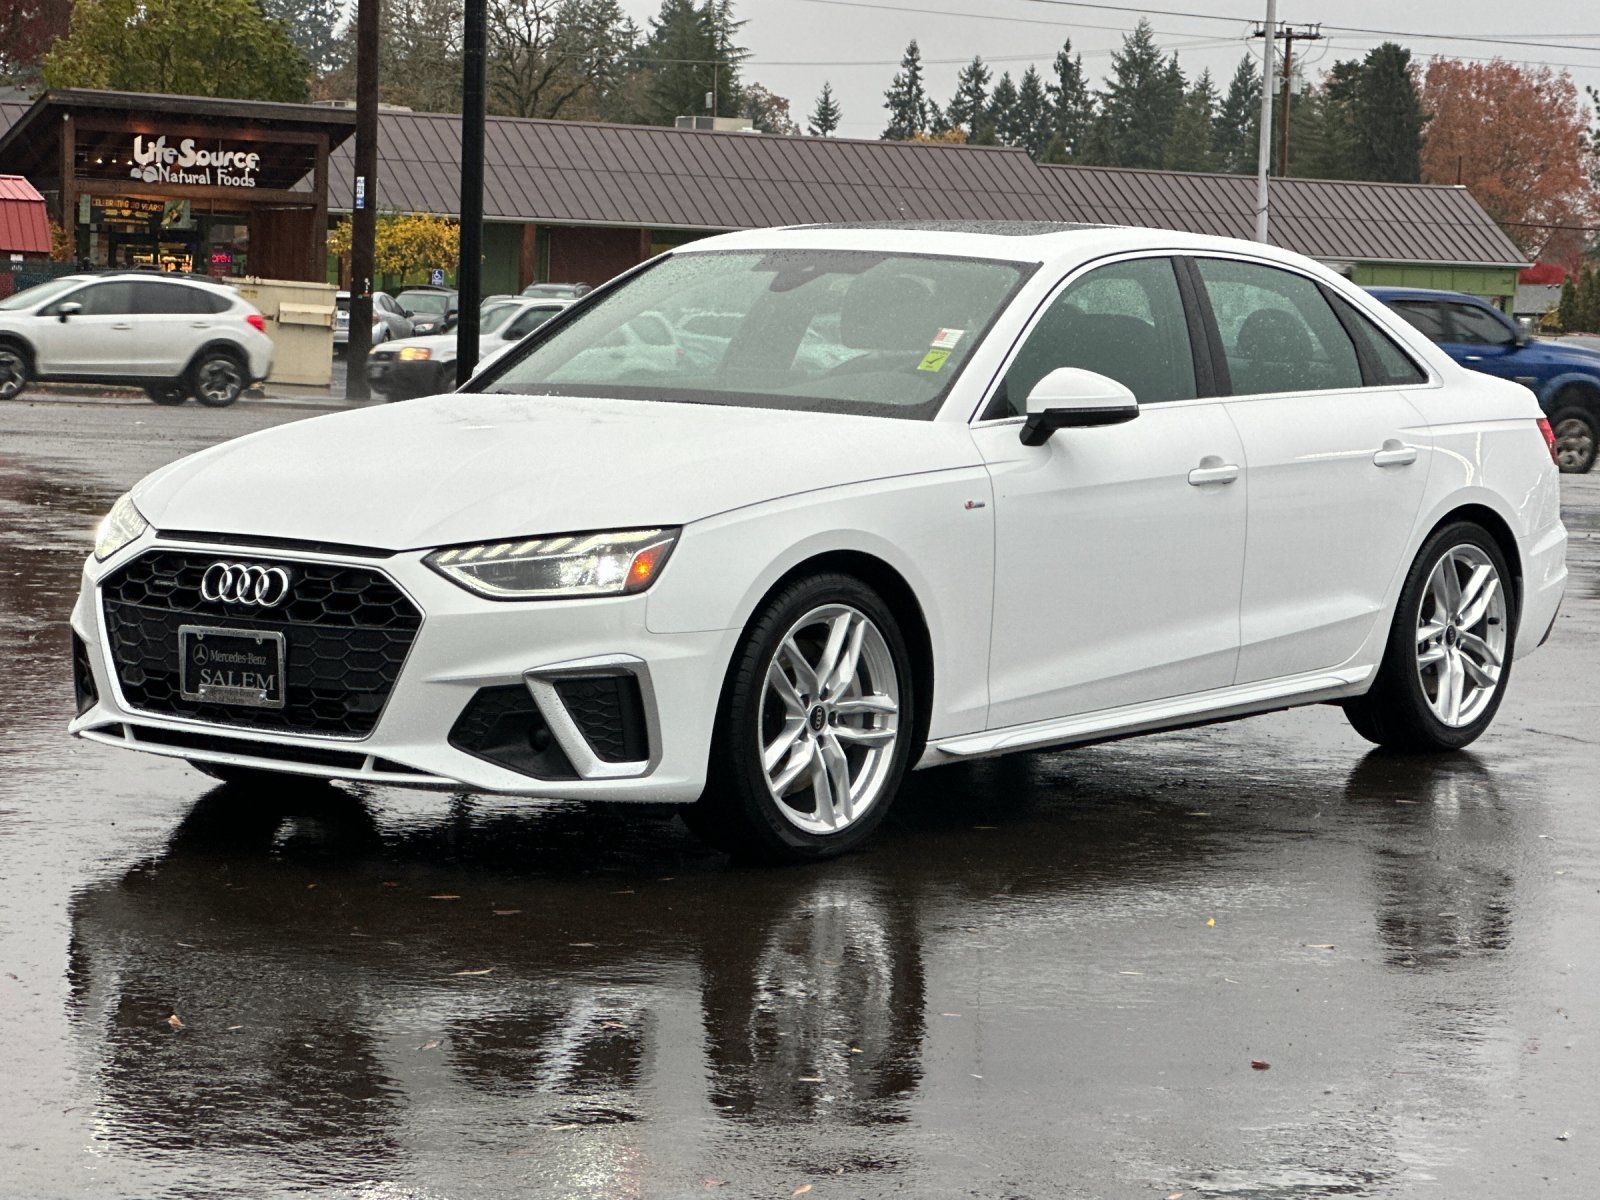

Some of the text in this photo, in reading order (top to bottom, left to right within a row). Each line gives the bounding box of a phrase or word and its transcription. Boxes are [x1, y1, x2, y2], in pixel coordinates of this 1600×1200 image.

[159, 165, 256, 187] Natural Foods
[211, 254, 232, 263] OPEN
[210, 649, 267, 665] Mercedes-Benz
[200, 668, 275, 691] SALEM
